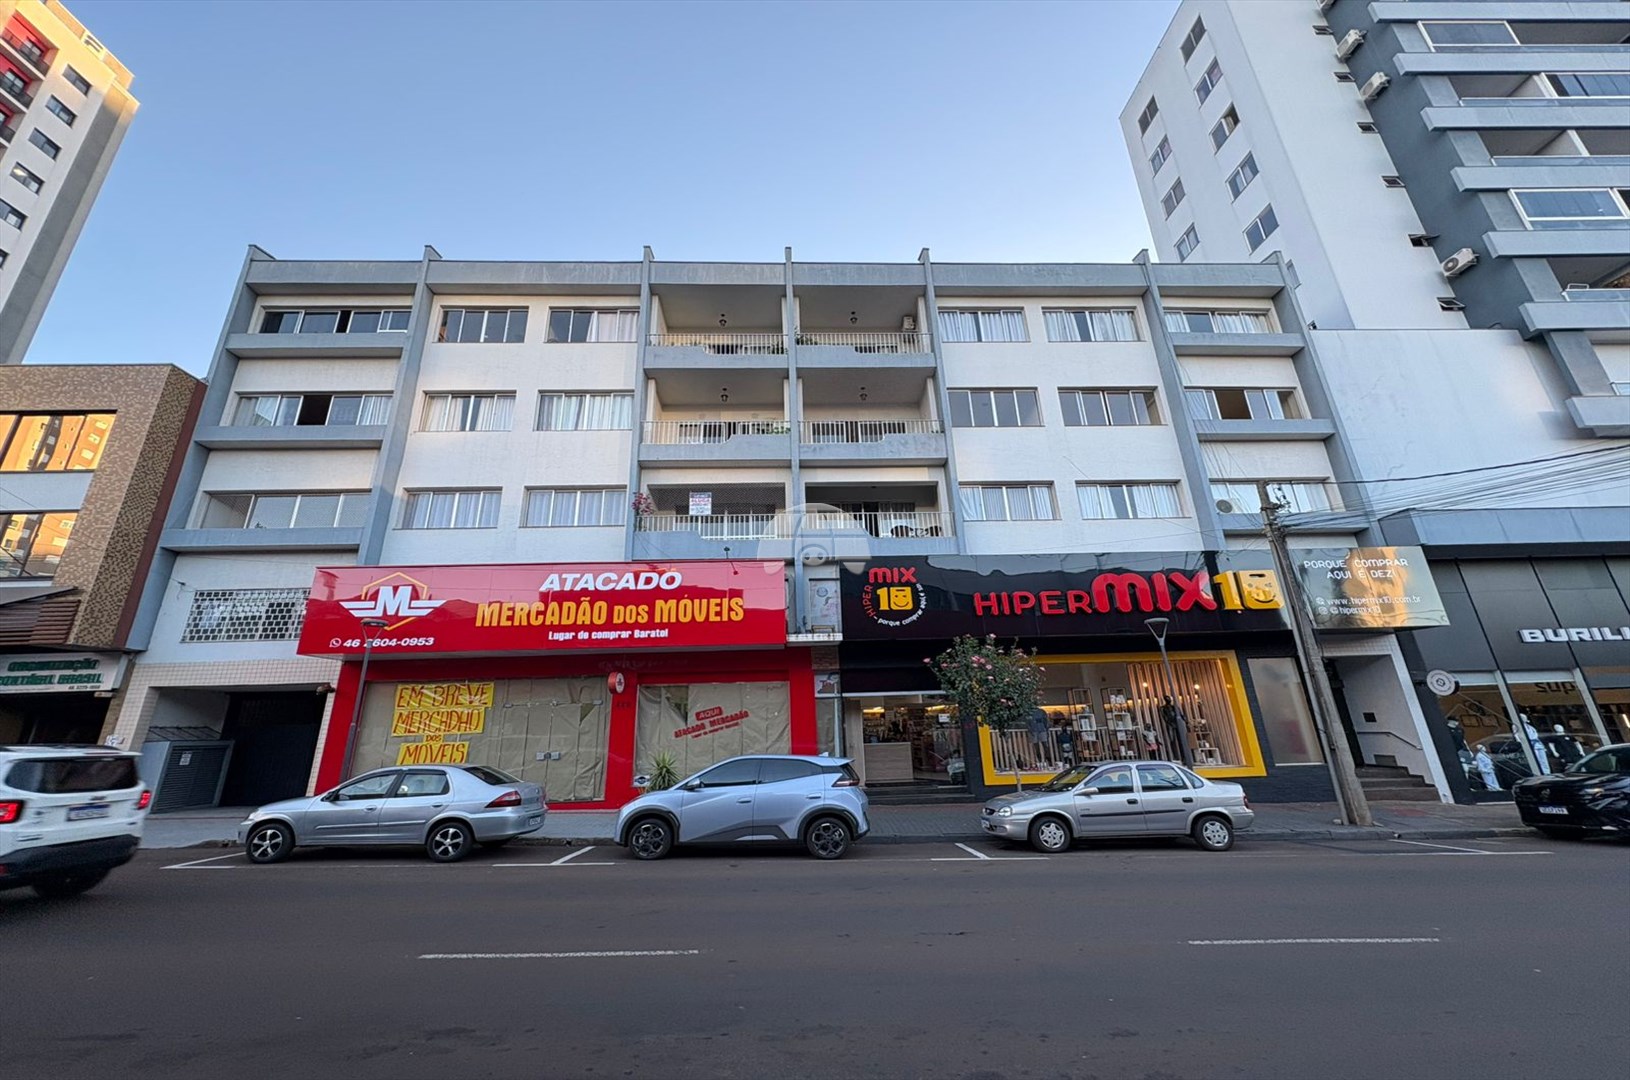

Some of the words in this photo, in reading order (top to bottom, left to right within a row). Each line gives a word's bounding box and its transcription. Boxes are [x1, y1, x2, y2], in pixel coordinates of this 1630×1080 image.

[1304, 560, 1347, 569] PORQUE
[1354, 558, 1408, 567] COMPRAR
[1327, 571, 1352, 579] AQUI
[539, 572, 682, 592] ATACADO
[475, 597, 608, 627] MERCADÃO
[654, 594, 745, 623] MÓVEIS
[548, 631, 575, 641] Lugar
[577, 630, 589, 639] de
[591, 629, 632, 640] comprar
[343, 639, 361, 648] 46
[397, 686, 424, 708] EM
[432, 683, 488, 707] BREVE
